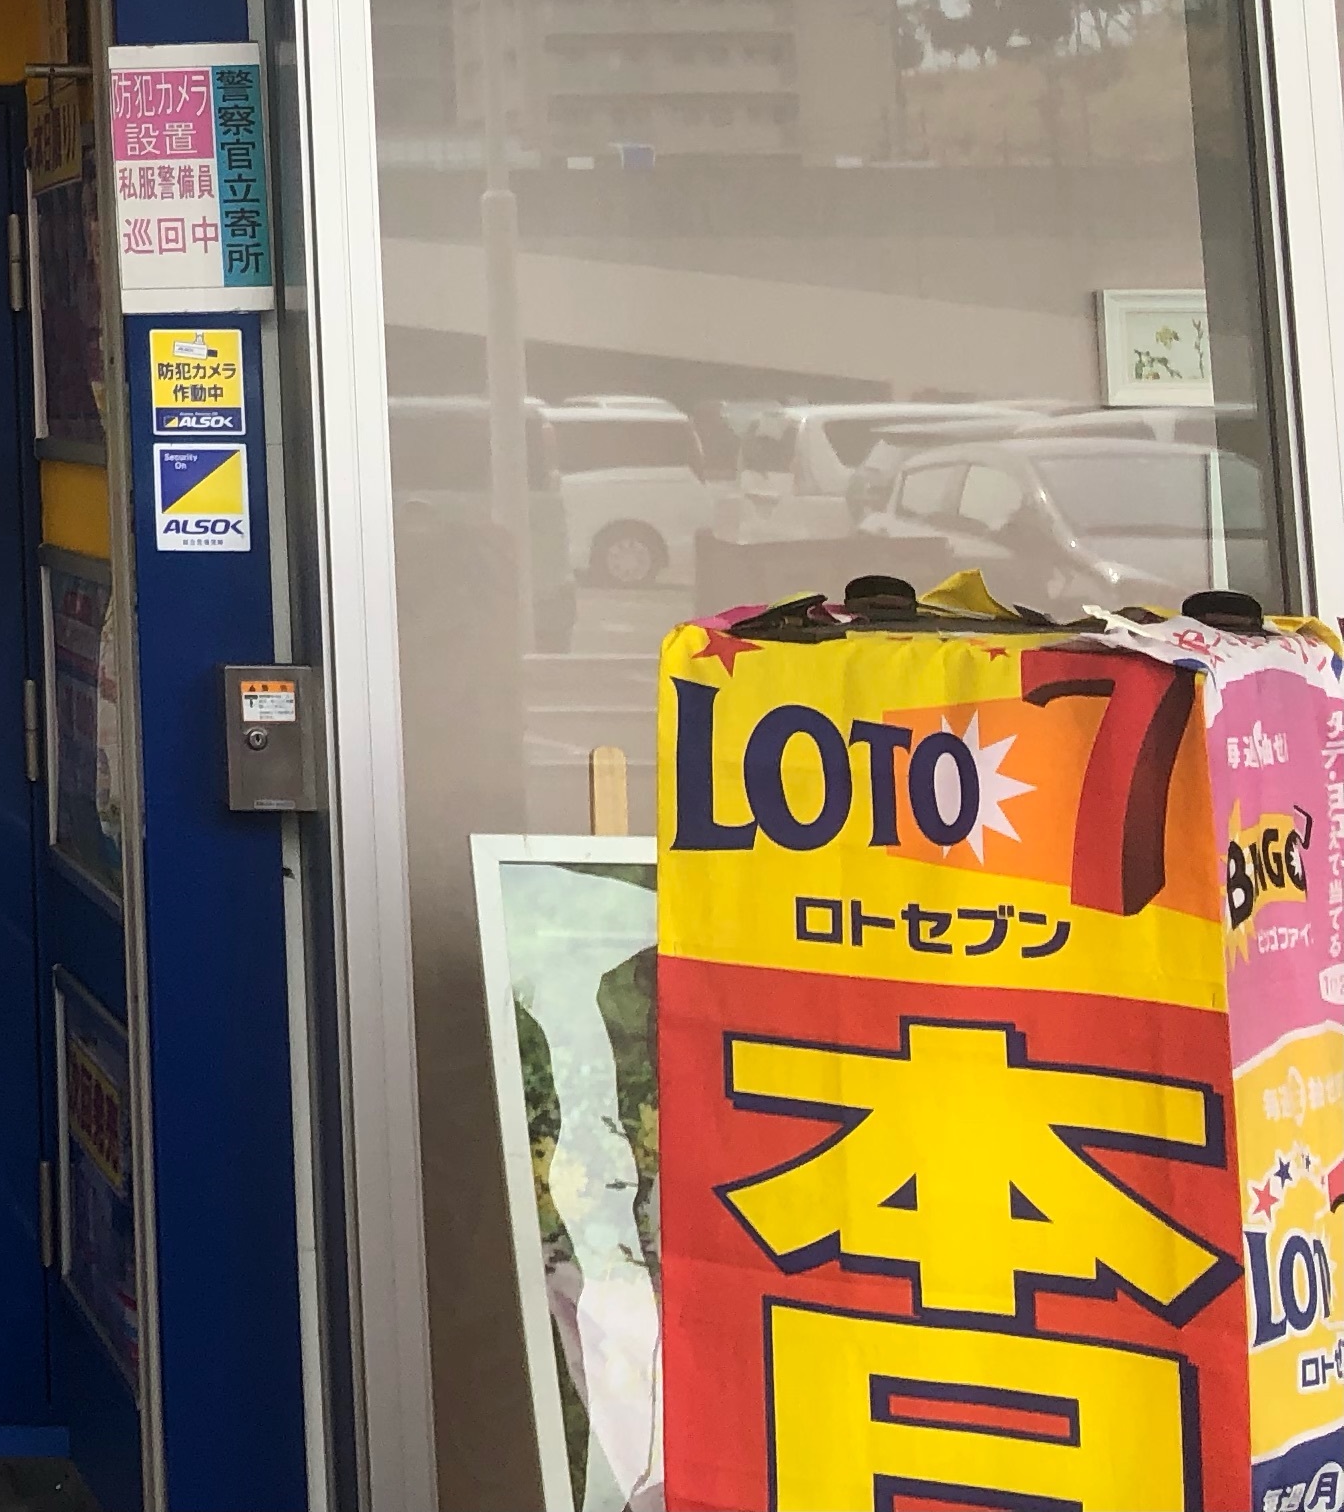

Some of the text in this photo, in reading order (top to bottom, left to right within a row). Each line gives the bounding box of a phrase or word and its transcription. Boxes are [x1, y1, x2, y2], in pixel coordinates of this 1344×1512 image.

[112, 74, 207, 119] 防犯カメラ
[125, 122, 198, 156] 設置
[119, 164, 215, 200] 私服警備員
[216, 69, 265, 274] 警察官立寄所
[123, 216, 219, 255] 巡回中
[157, 362, 237, 380] 防犯カメラ
[172, 384, 224, 402] 作動中
[179, 416, 234, 428] ALSOK
[164, 453, 198, 462] Security
[175, 461, 187, 470] On
[163, 519, 244, 535] ALSOK
[671, 650, 1196, 916] LOTO 7
[794, 896, 1071, 959] ロトセブン
